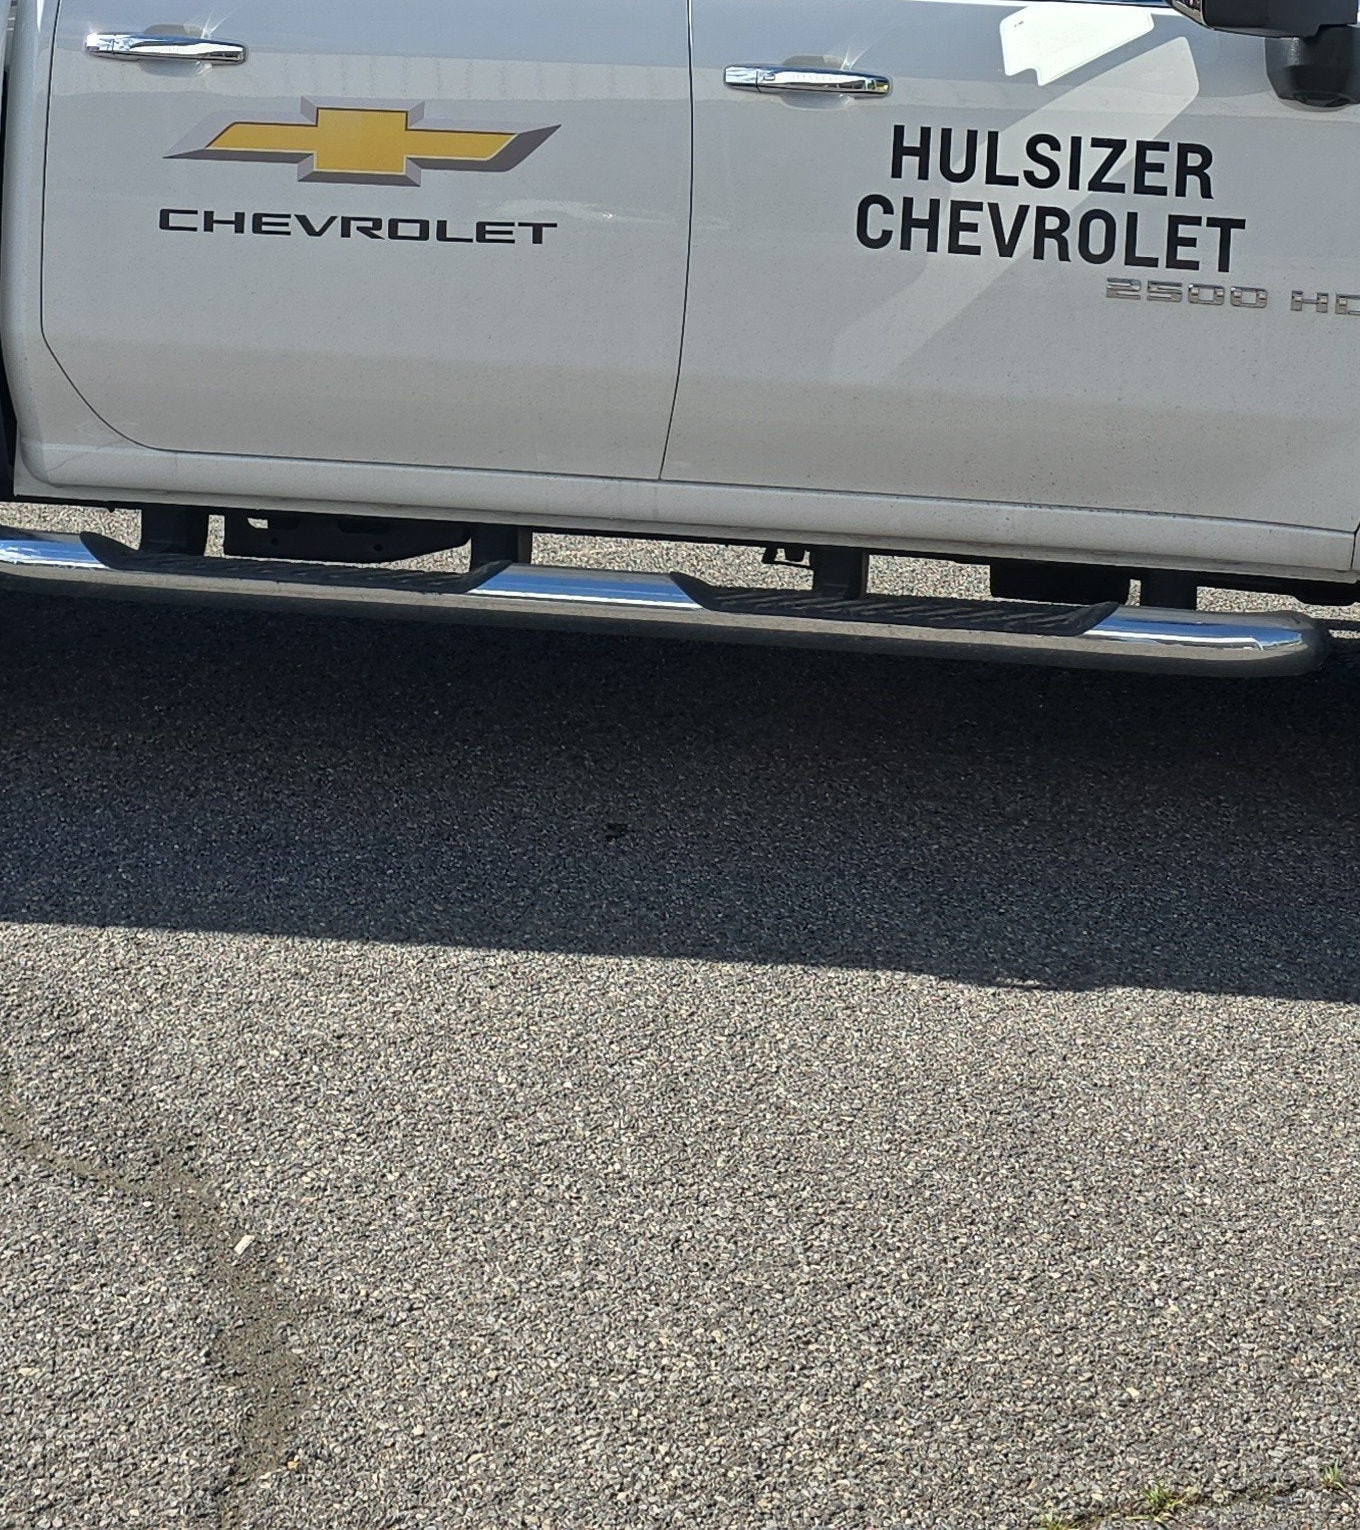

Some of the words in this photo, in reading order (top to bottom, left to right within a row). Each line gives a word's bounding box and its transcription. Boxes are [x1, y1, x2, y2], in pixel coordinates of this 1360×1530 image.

[890, 123, 1215, 200] HULSIZER
[158, 207, 558, 245] CHEVROLET
[855, 193, 1247, 273] CHEVROLET
[1105, 277, 1269, 309] 2500
